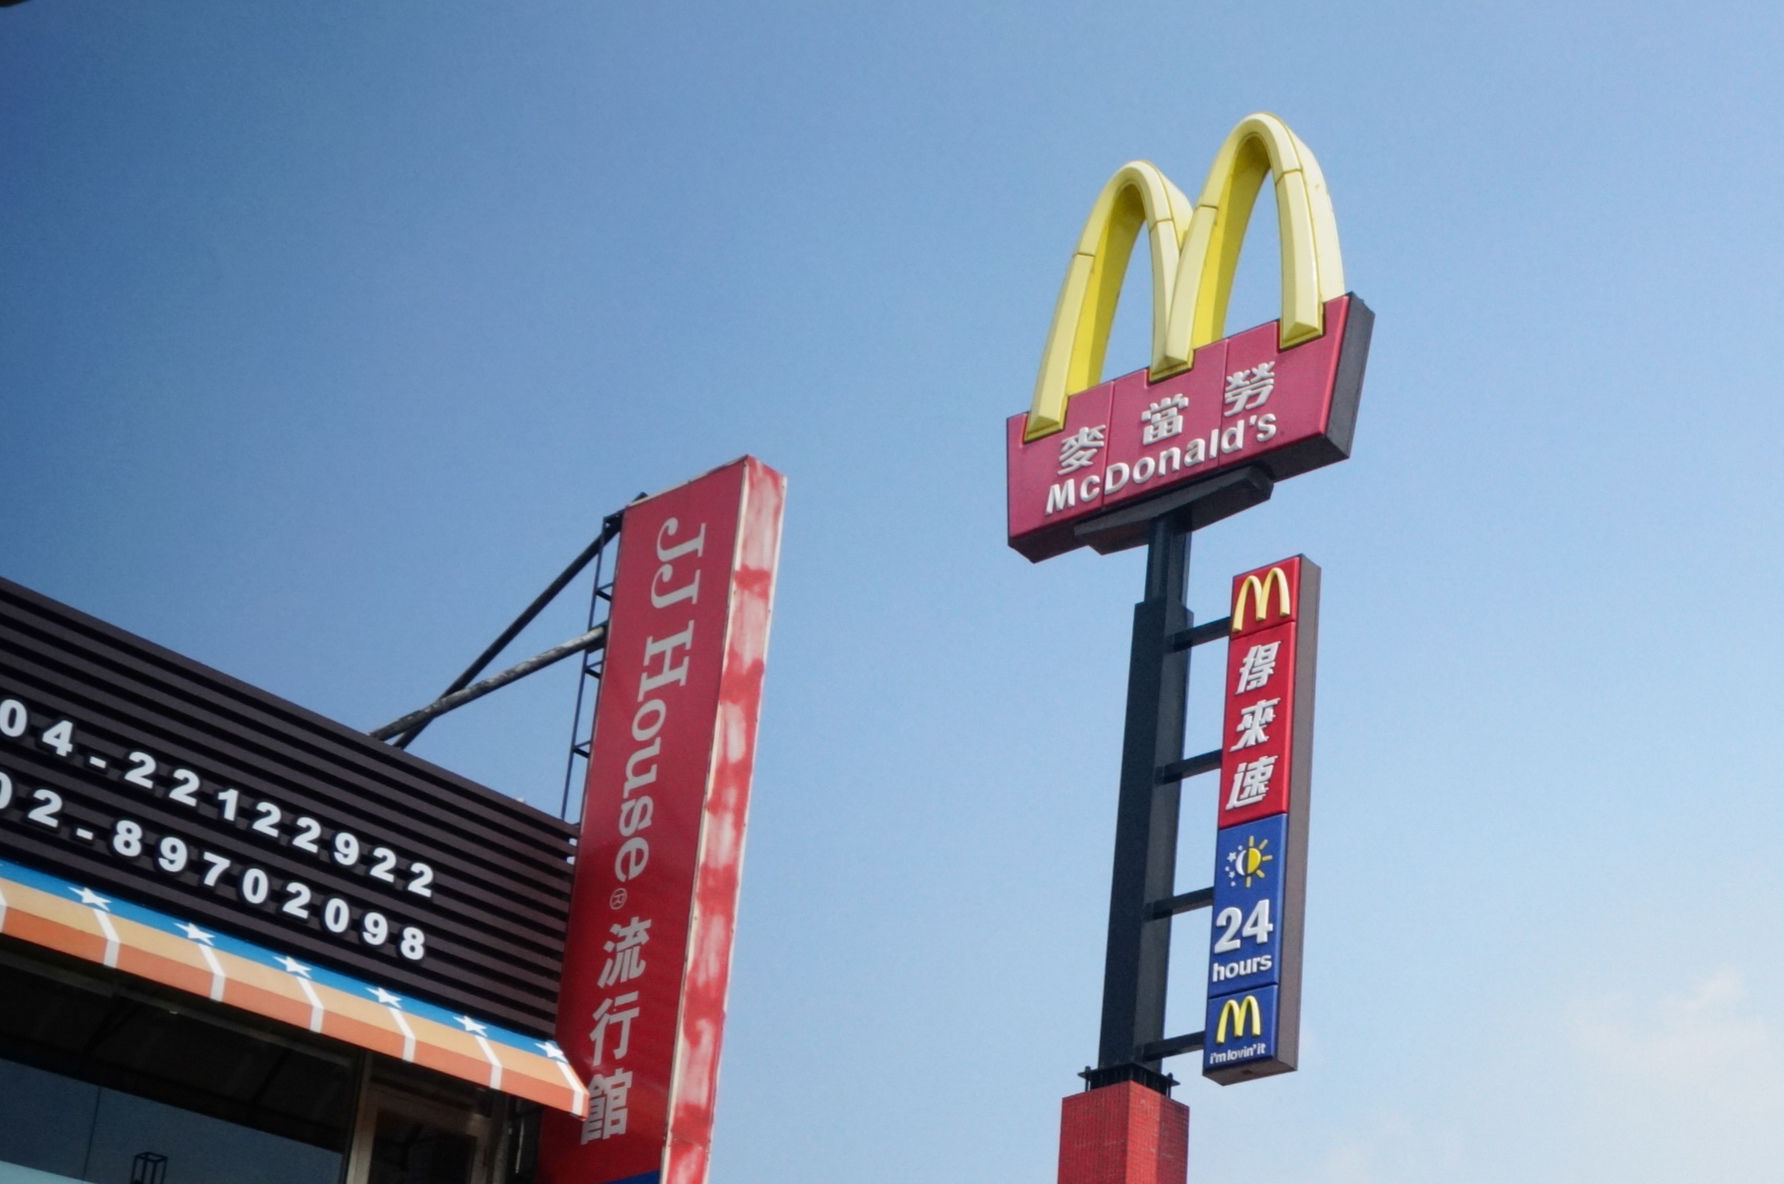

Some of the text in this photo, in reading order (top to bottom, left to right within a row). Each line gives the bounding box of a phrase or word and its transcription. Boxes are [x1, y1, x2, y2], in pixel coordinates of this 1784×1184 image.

[1044, 411, 1278, 516] McDonald's
[1057, 360, 1276, 476] 麥當勞
[1225, 640, 1283, 812] 得來速
[580, 516, 707, 1147] JJ House 流行館
[1212, 954, 1273, 983] hours
[1213, 898, 1274, 956] 24
